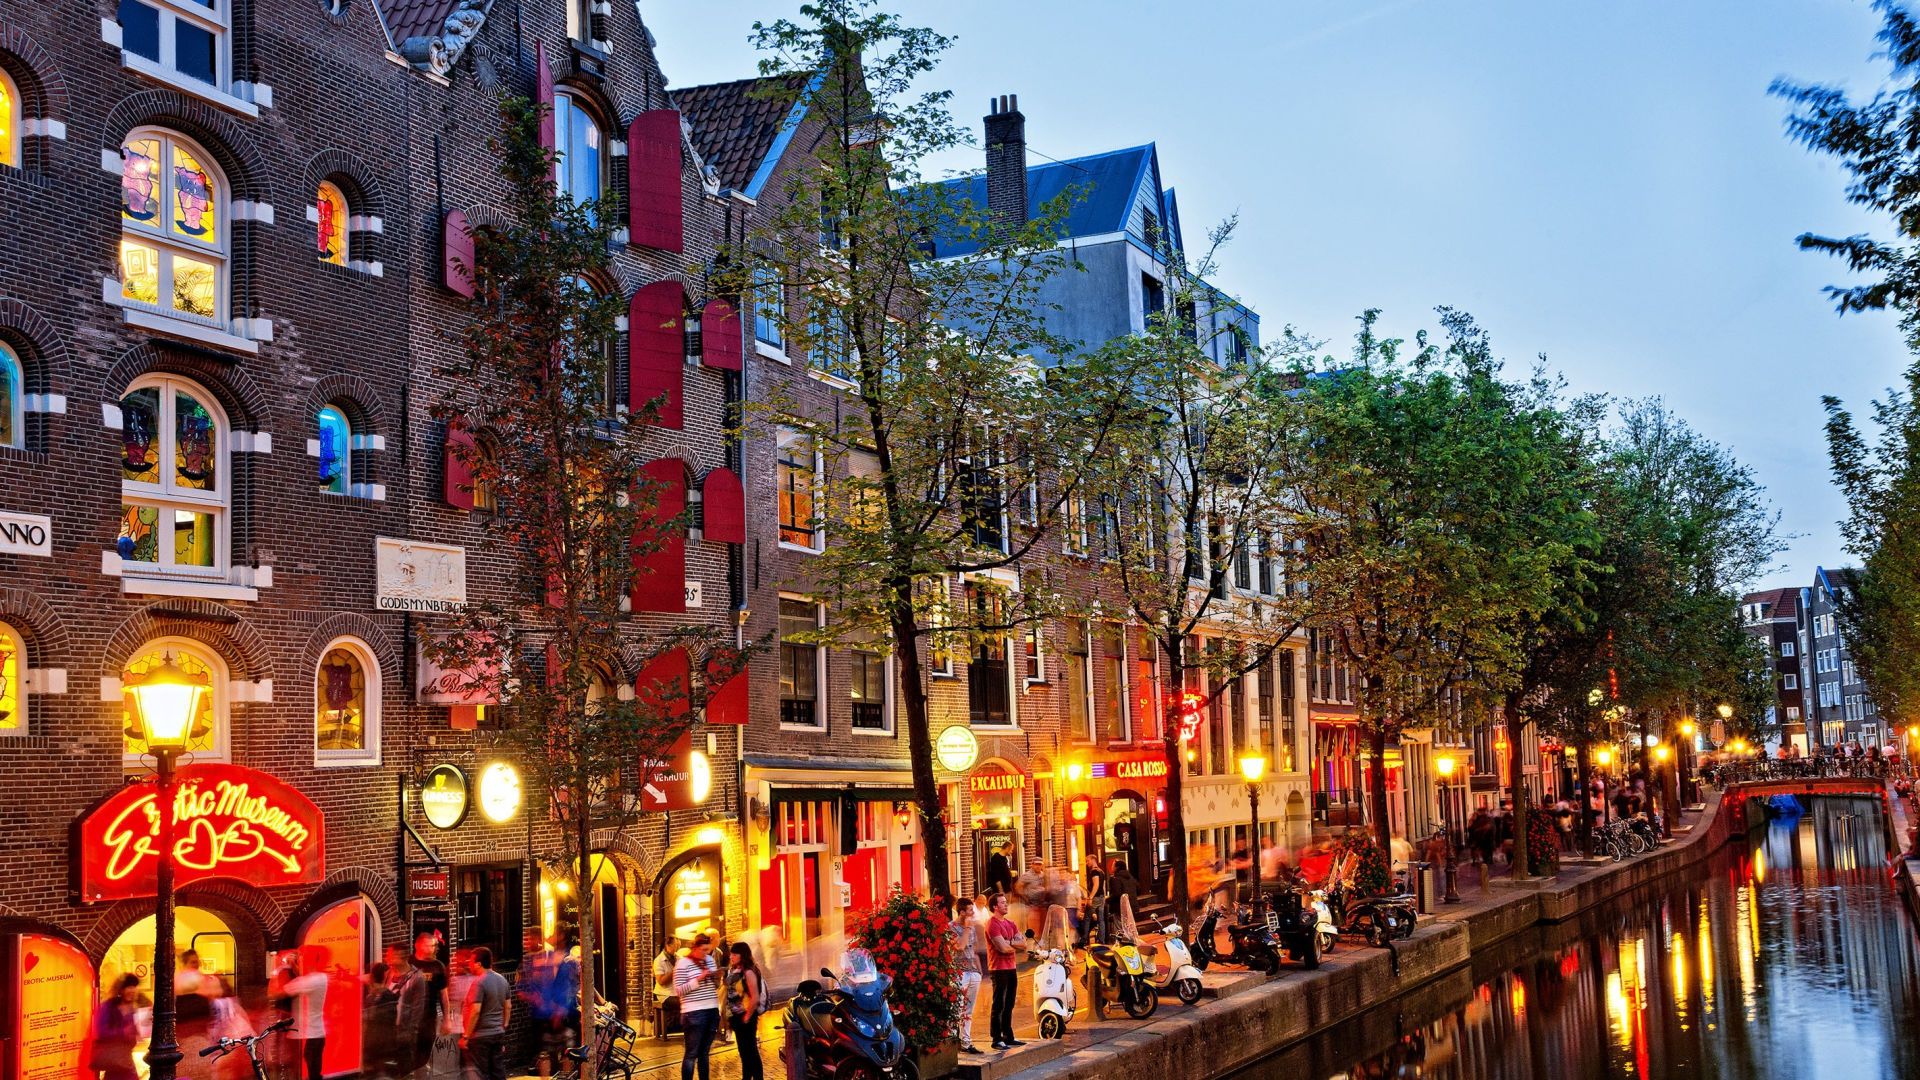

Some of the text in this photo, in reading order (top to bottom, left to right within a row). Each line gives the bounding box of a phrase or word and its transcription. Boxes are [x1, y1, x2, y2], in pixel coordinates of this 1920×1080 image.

[1117, 760, 1167, 778] CASA ROSSO
[970, 774, 1026, 792] EXCALIBUR
[215, 780, 309, 850] Museum
[834, 861, 842, 871] 50
[412, 880, 444, 890] MUSEUM
[23, 973, 74, 986] EROTIC MUSEUM
